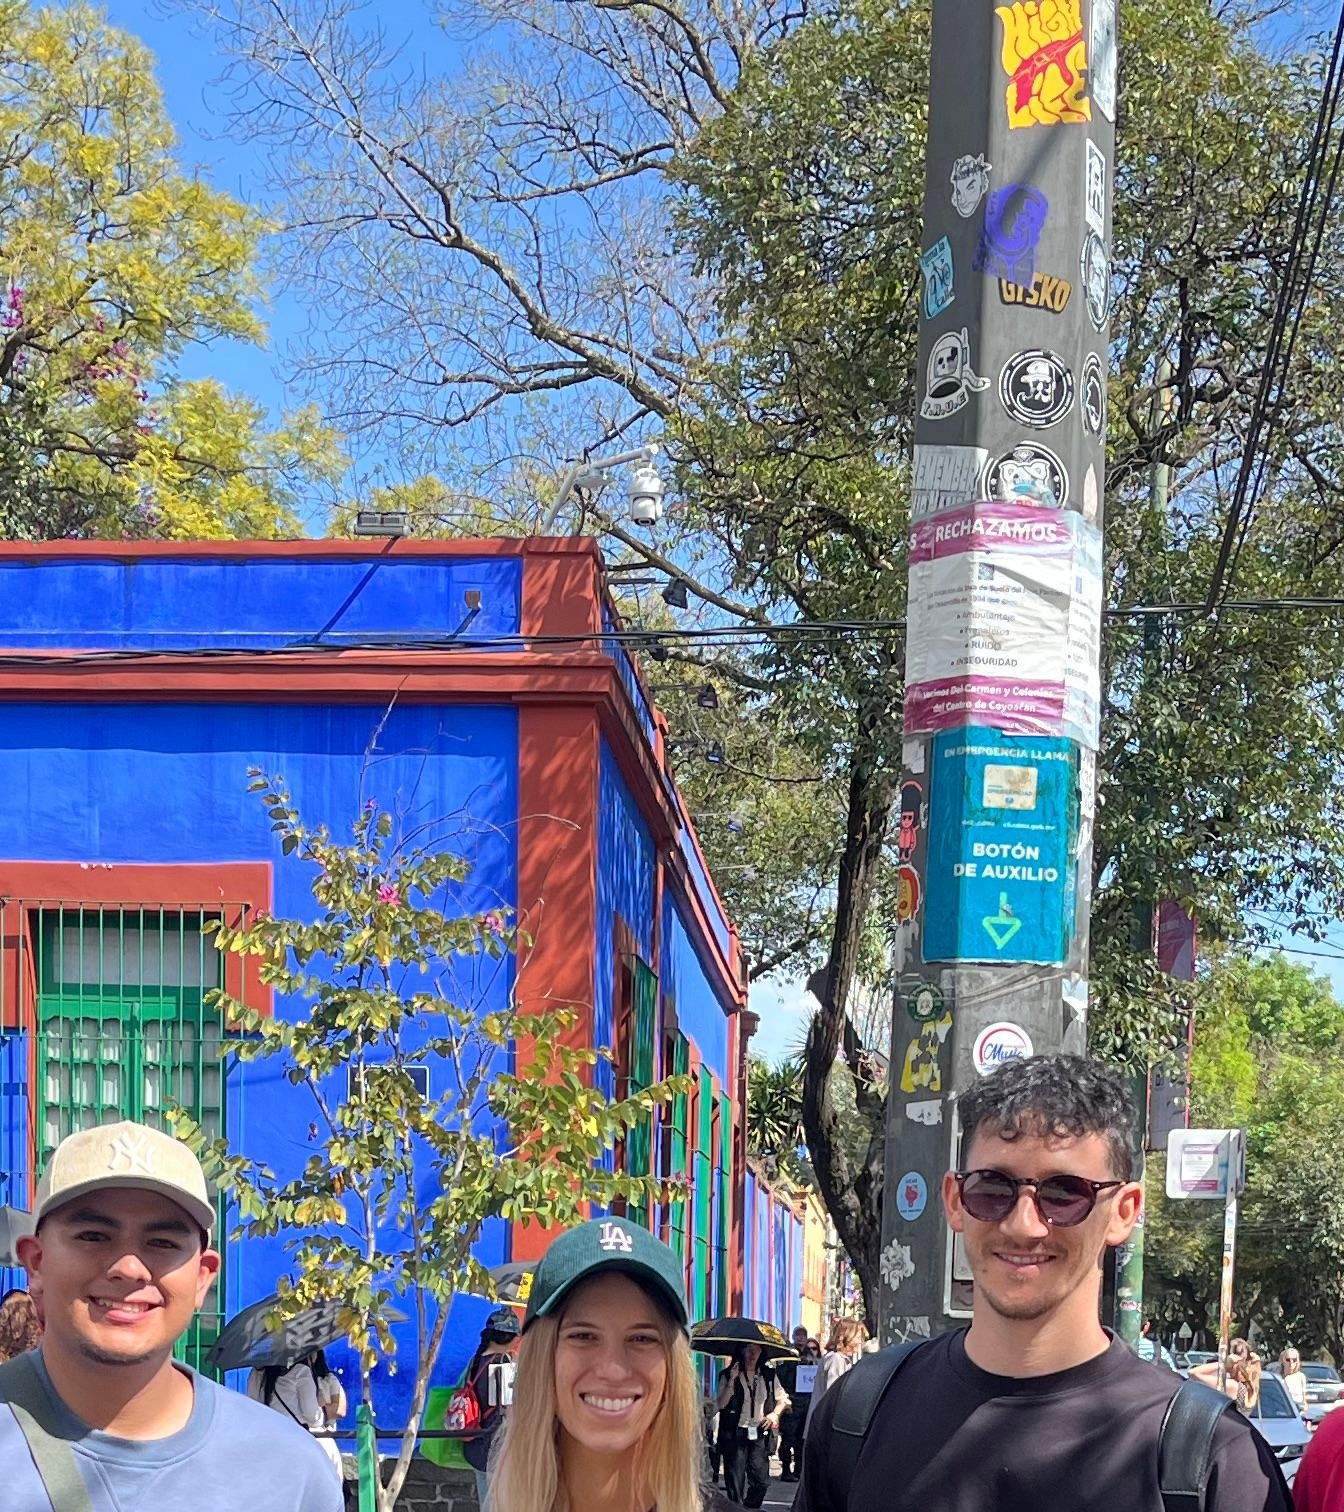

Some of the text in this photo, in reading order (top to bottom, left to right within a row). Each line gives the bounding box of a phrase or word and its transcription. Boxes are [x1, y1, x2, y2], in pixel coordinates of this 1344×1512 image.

[935, 518, 1057, 543] RECHAZAMOS
[965, 684, 1002, 695] Carmen
[972, 842, 1040, 861] BOTÓN
[953, 863, 1058, 882] DE AUXILIO
[599, 1222, 632, 1252] LA
